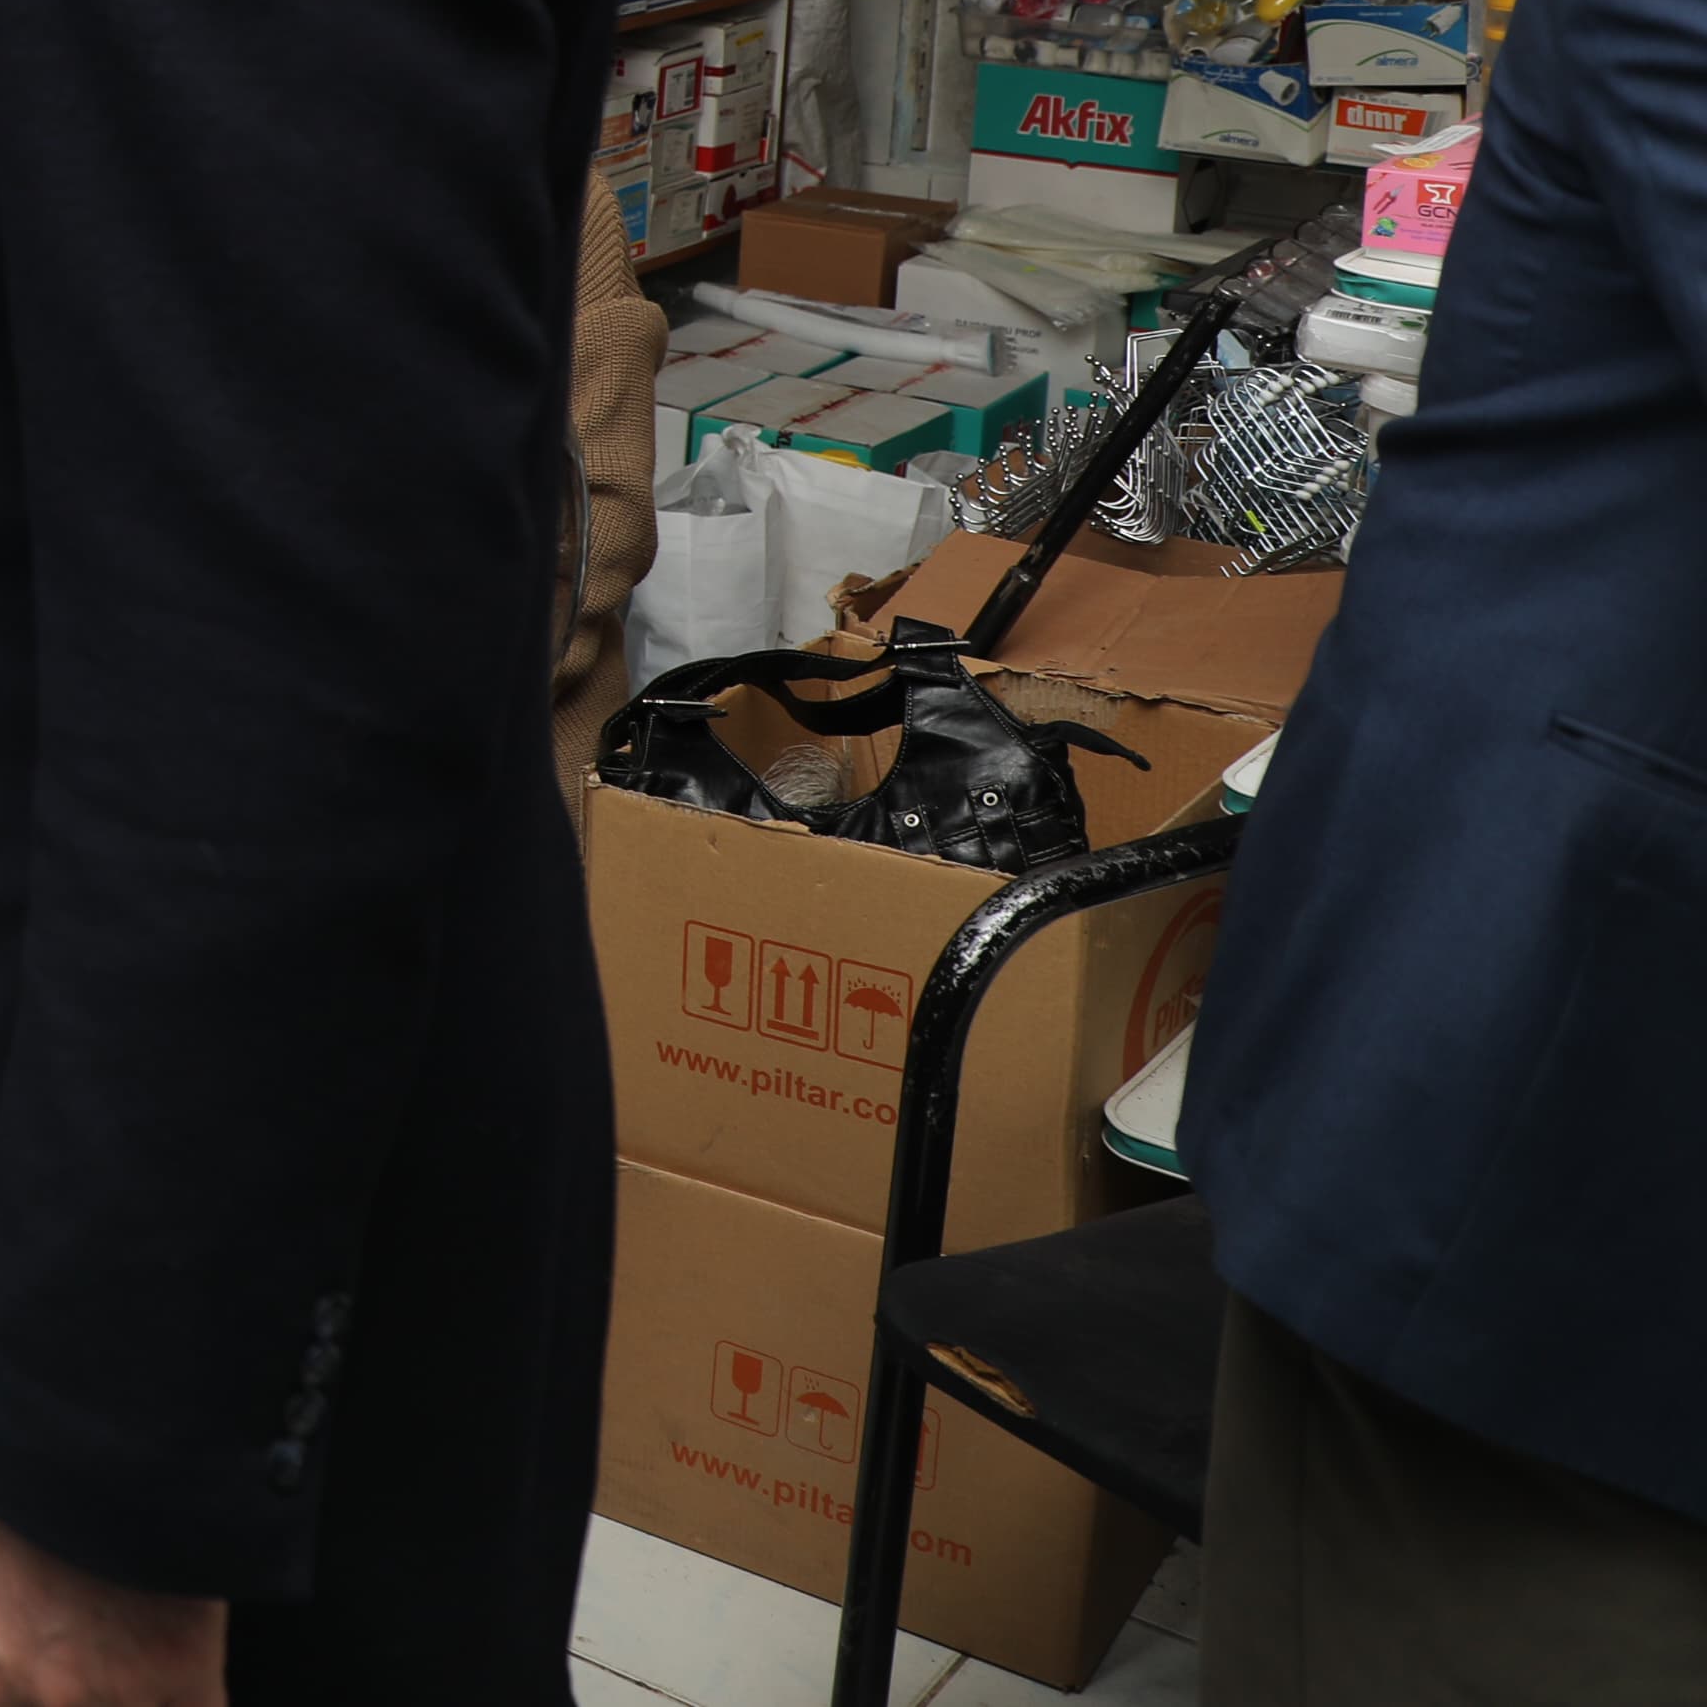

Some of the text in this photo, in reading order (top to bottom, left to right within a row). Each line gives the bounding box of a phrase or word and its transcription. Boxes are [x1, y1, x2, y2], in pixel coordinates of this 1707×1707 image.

[1019, 95, 1134, 146] Akfix
[1346, 105, 1409, 133] dmr
[656, 1040, 899, 1126] www.piltar.co
